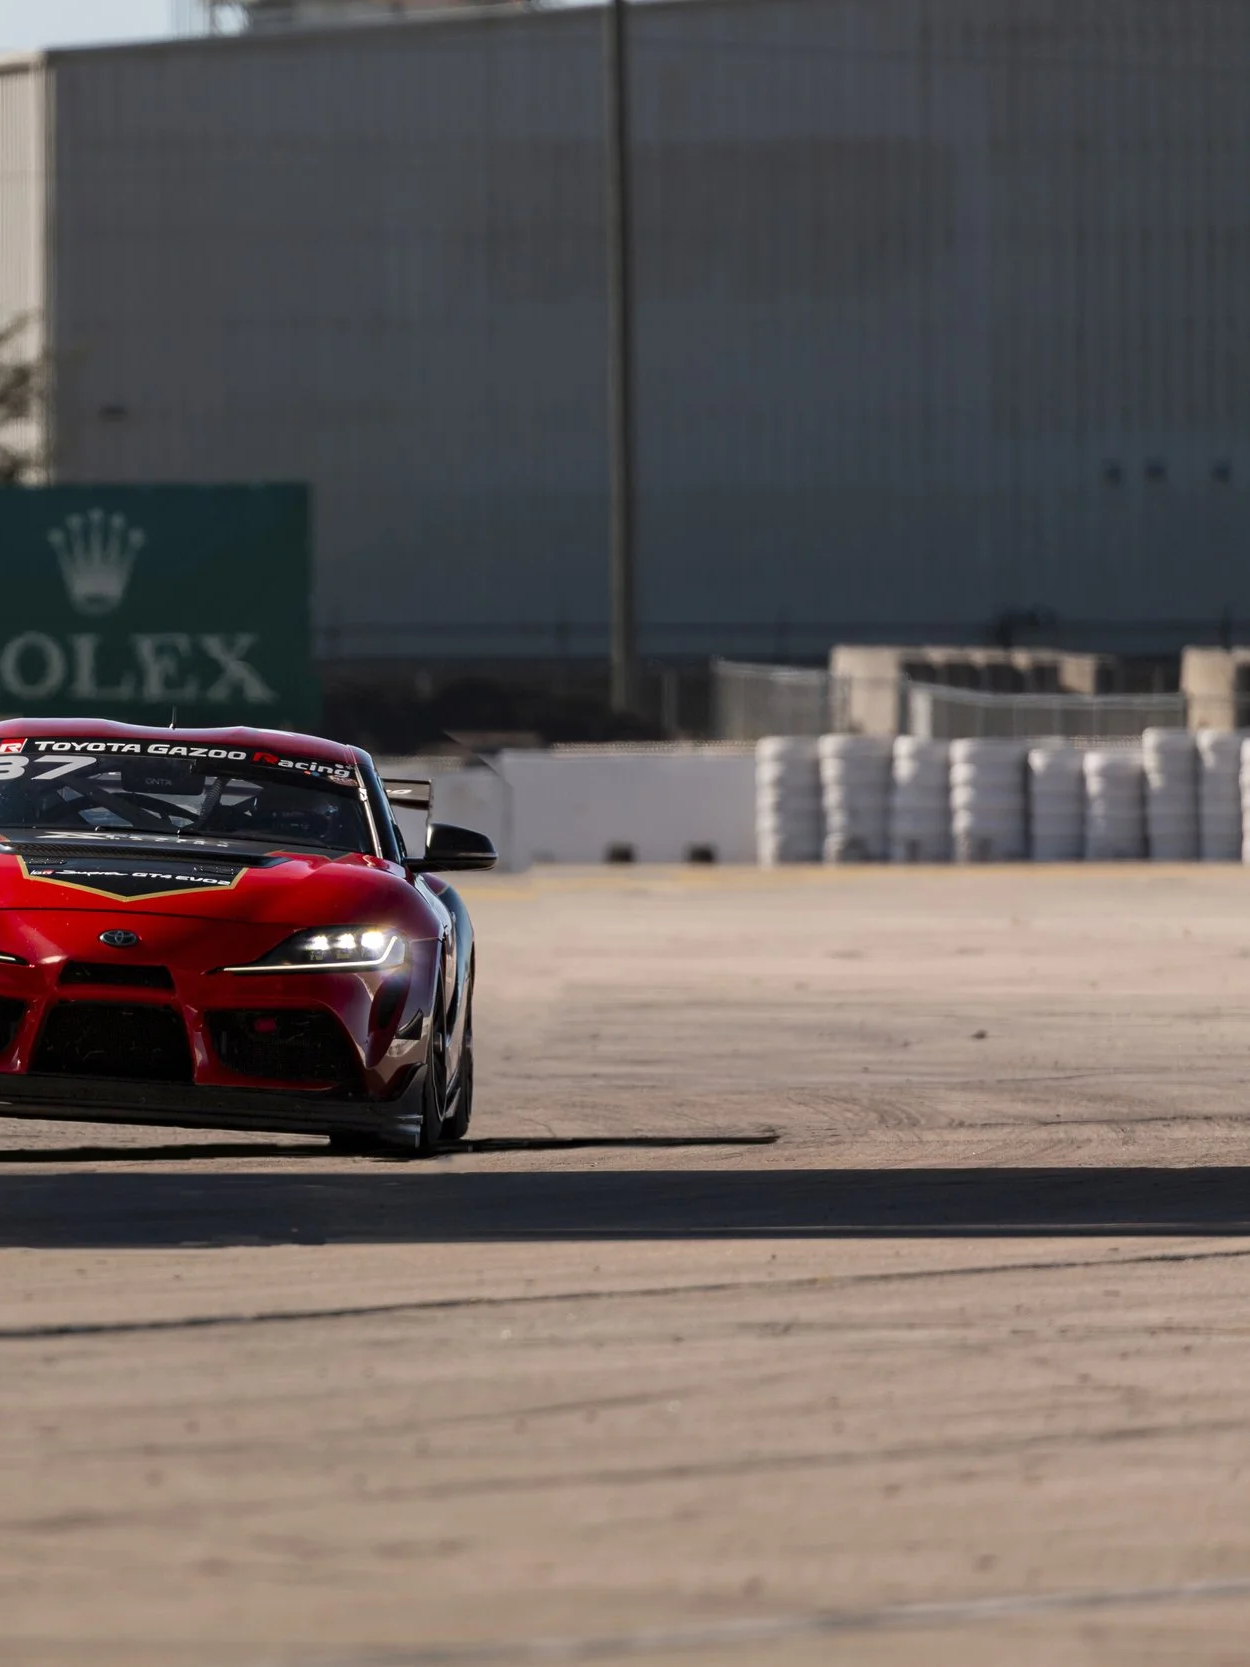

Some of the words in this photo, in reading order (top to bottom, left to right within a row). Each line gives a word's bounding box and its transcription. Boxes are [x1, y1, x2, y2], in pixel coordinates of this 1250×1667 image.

[34, 740, 142, 755] TOYOTA
[146, 743, 247, 760] GAZOO
[253, 750, 352, 779] Racing
[131, 871, 173, 880] GT4
[175, 875, 232, 887] EVO2
